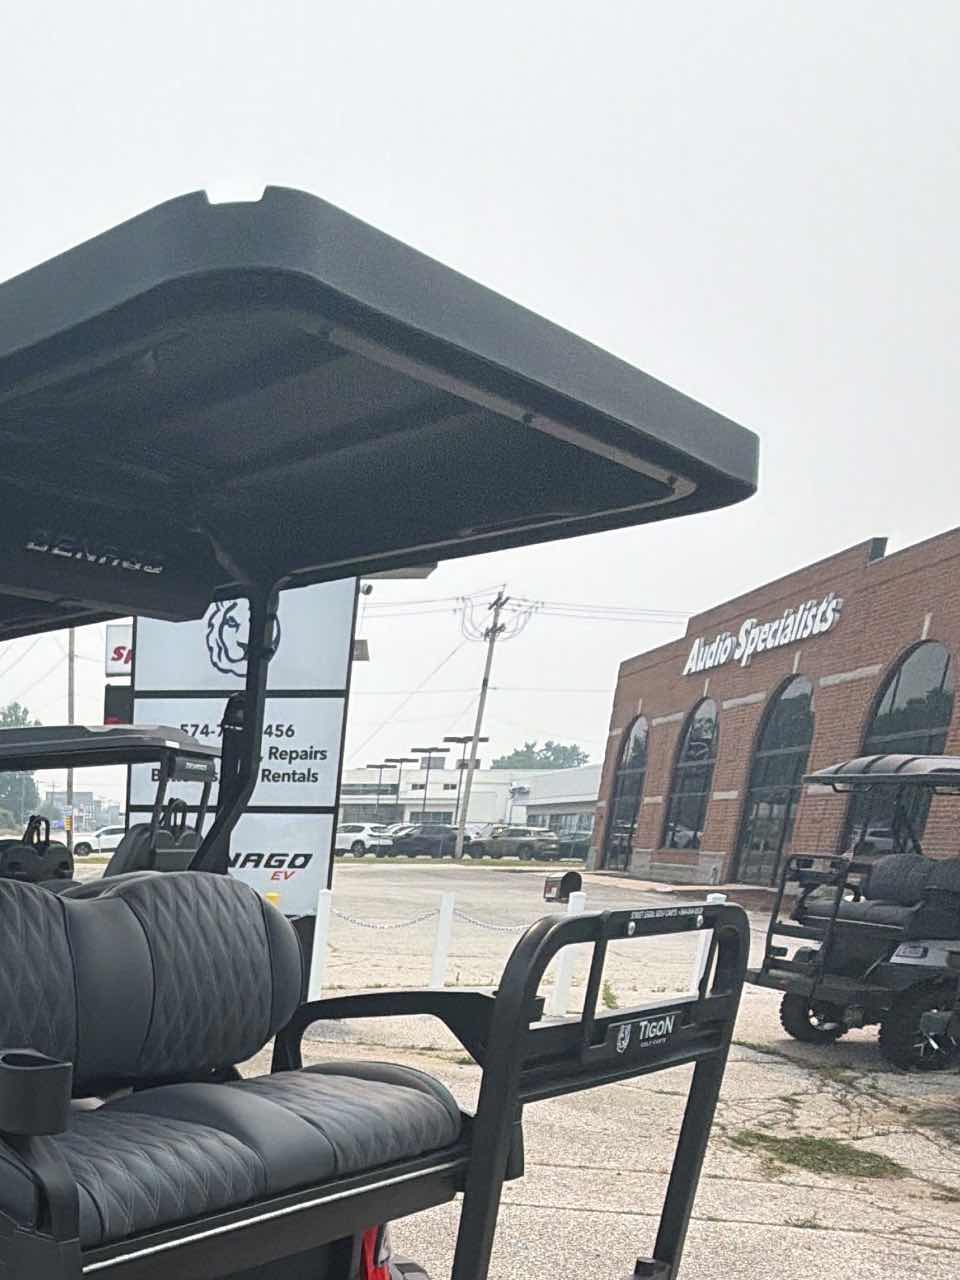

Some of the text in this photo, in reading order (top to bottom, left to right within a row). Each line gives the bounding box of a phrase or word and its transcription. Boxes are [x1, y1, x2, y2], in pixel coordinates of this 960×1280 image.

[682, 592, 842, 675] Audio Specialists
[180, 724, 295, 738] 574-7456
[268, 746, 328, 765] Repairs
[261, 768, 319, 783] Rentals
[228, 853, 313, 869] NAGO
[271, 870, 296, 881] EV
[640, 1015, 675, 1040] TIGON
